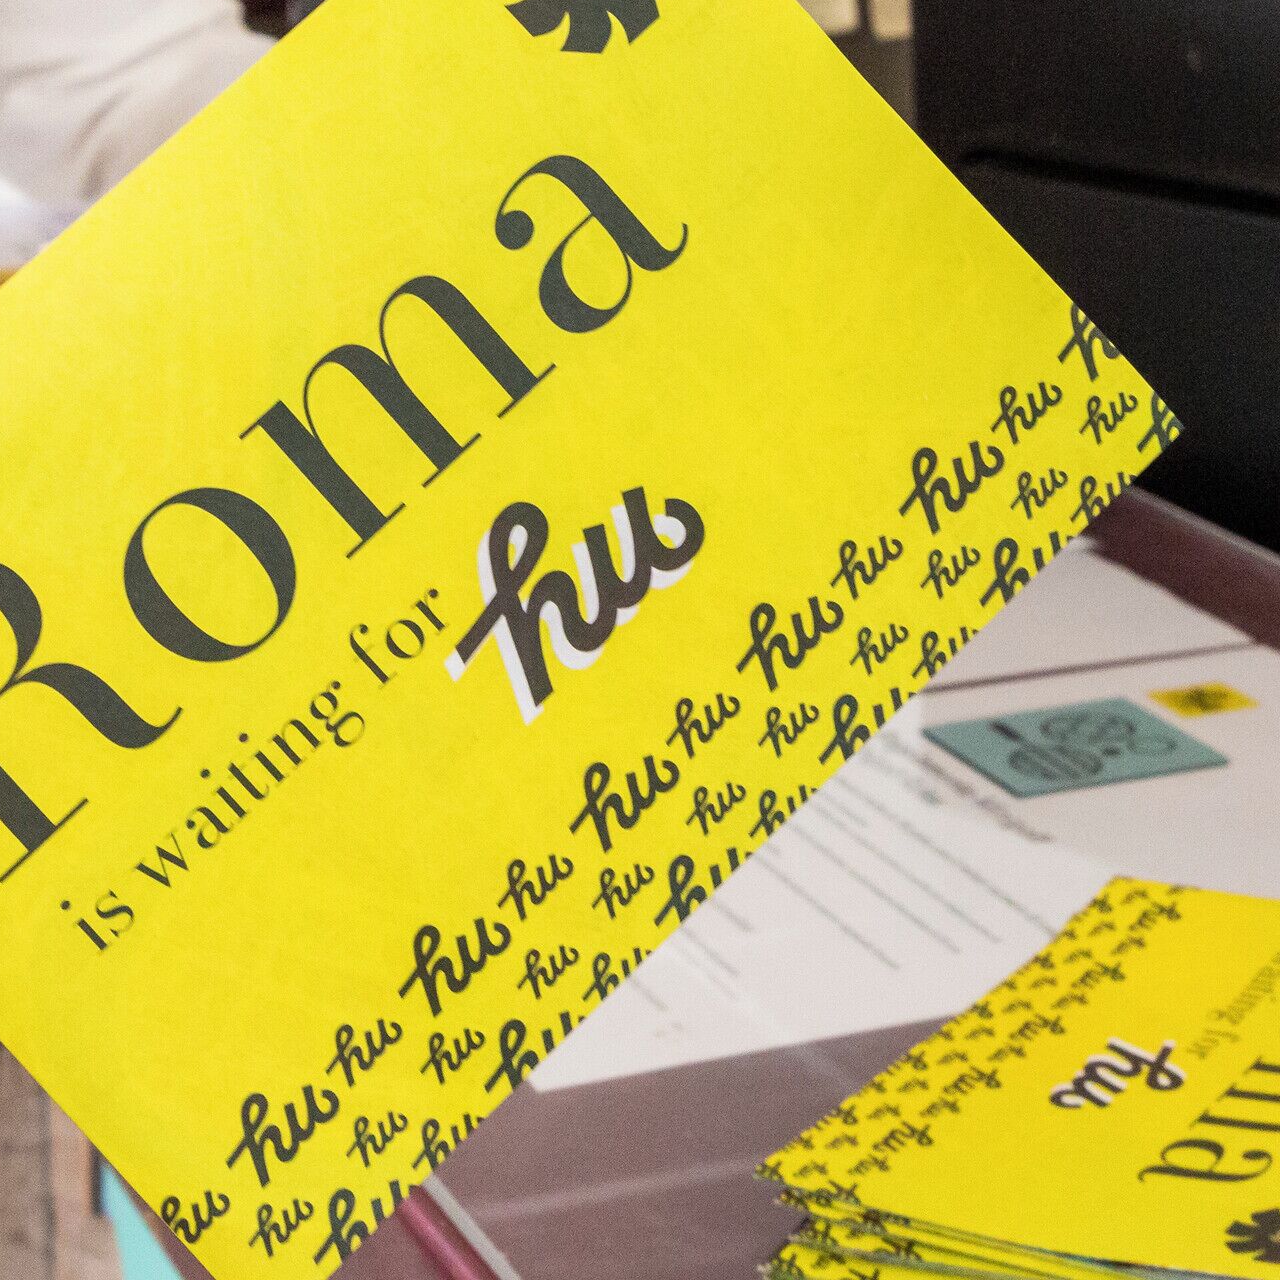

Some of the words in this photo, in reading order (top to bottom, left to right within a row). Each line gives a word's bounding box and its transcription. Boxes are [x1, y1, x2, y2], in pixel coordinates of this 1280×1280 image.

[59, 898, 136, 954] is
[134, 680, 366, 890] waiting
[349, 587, 450, 689] for
